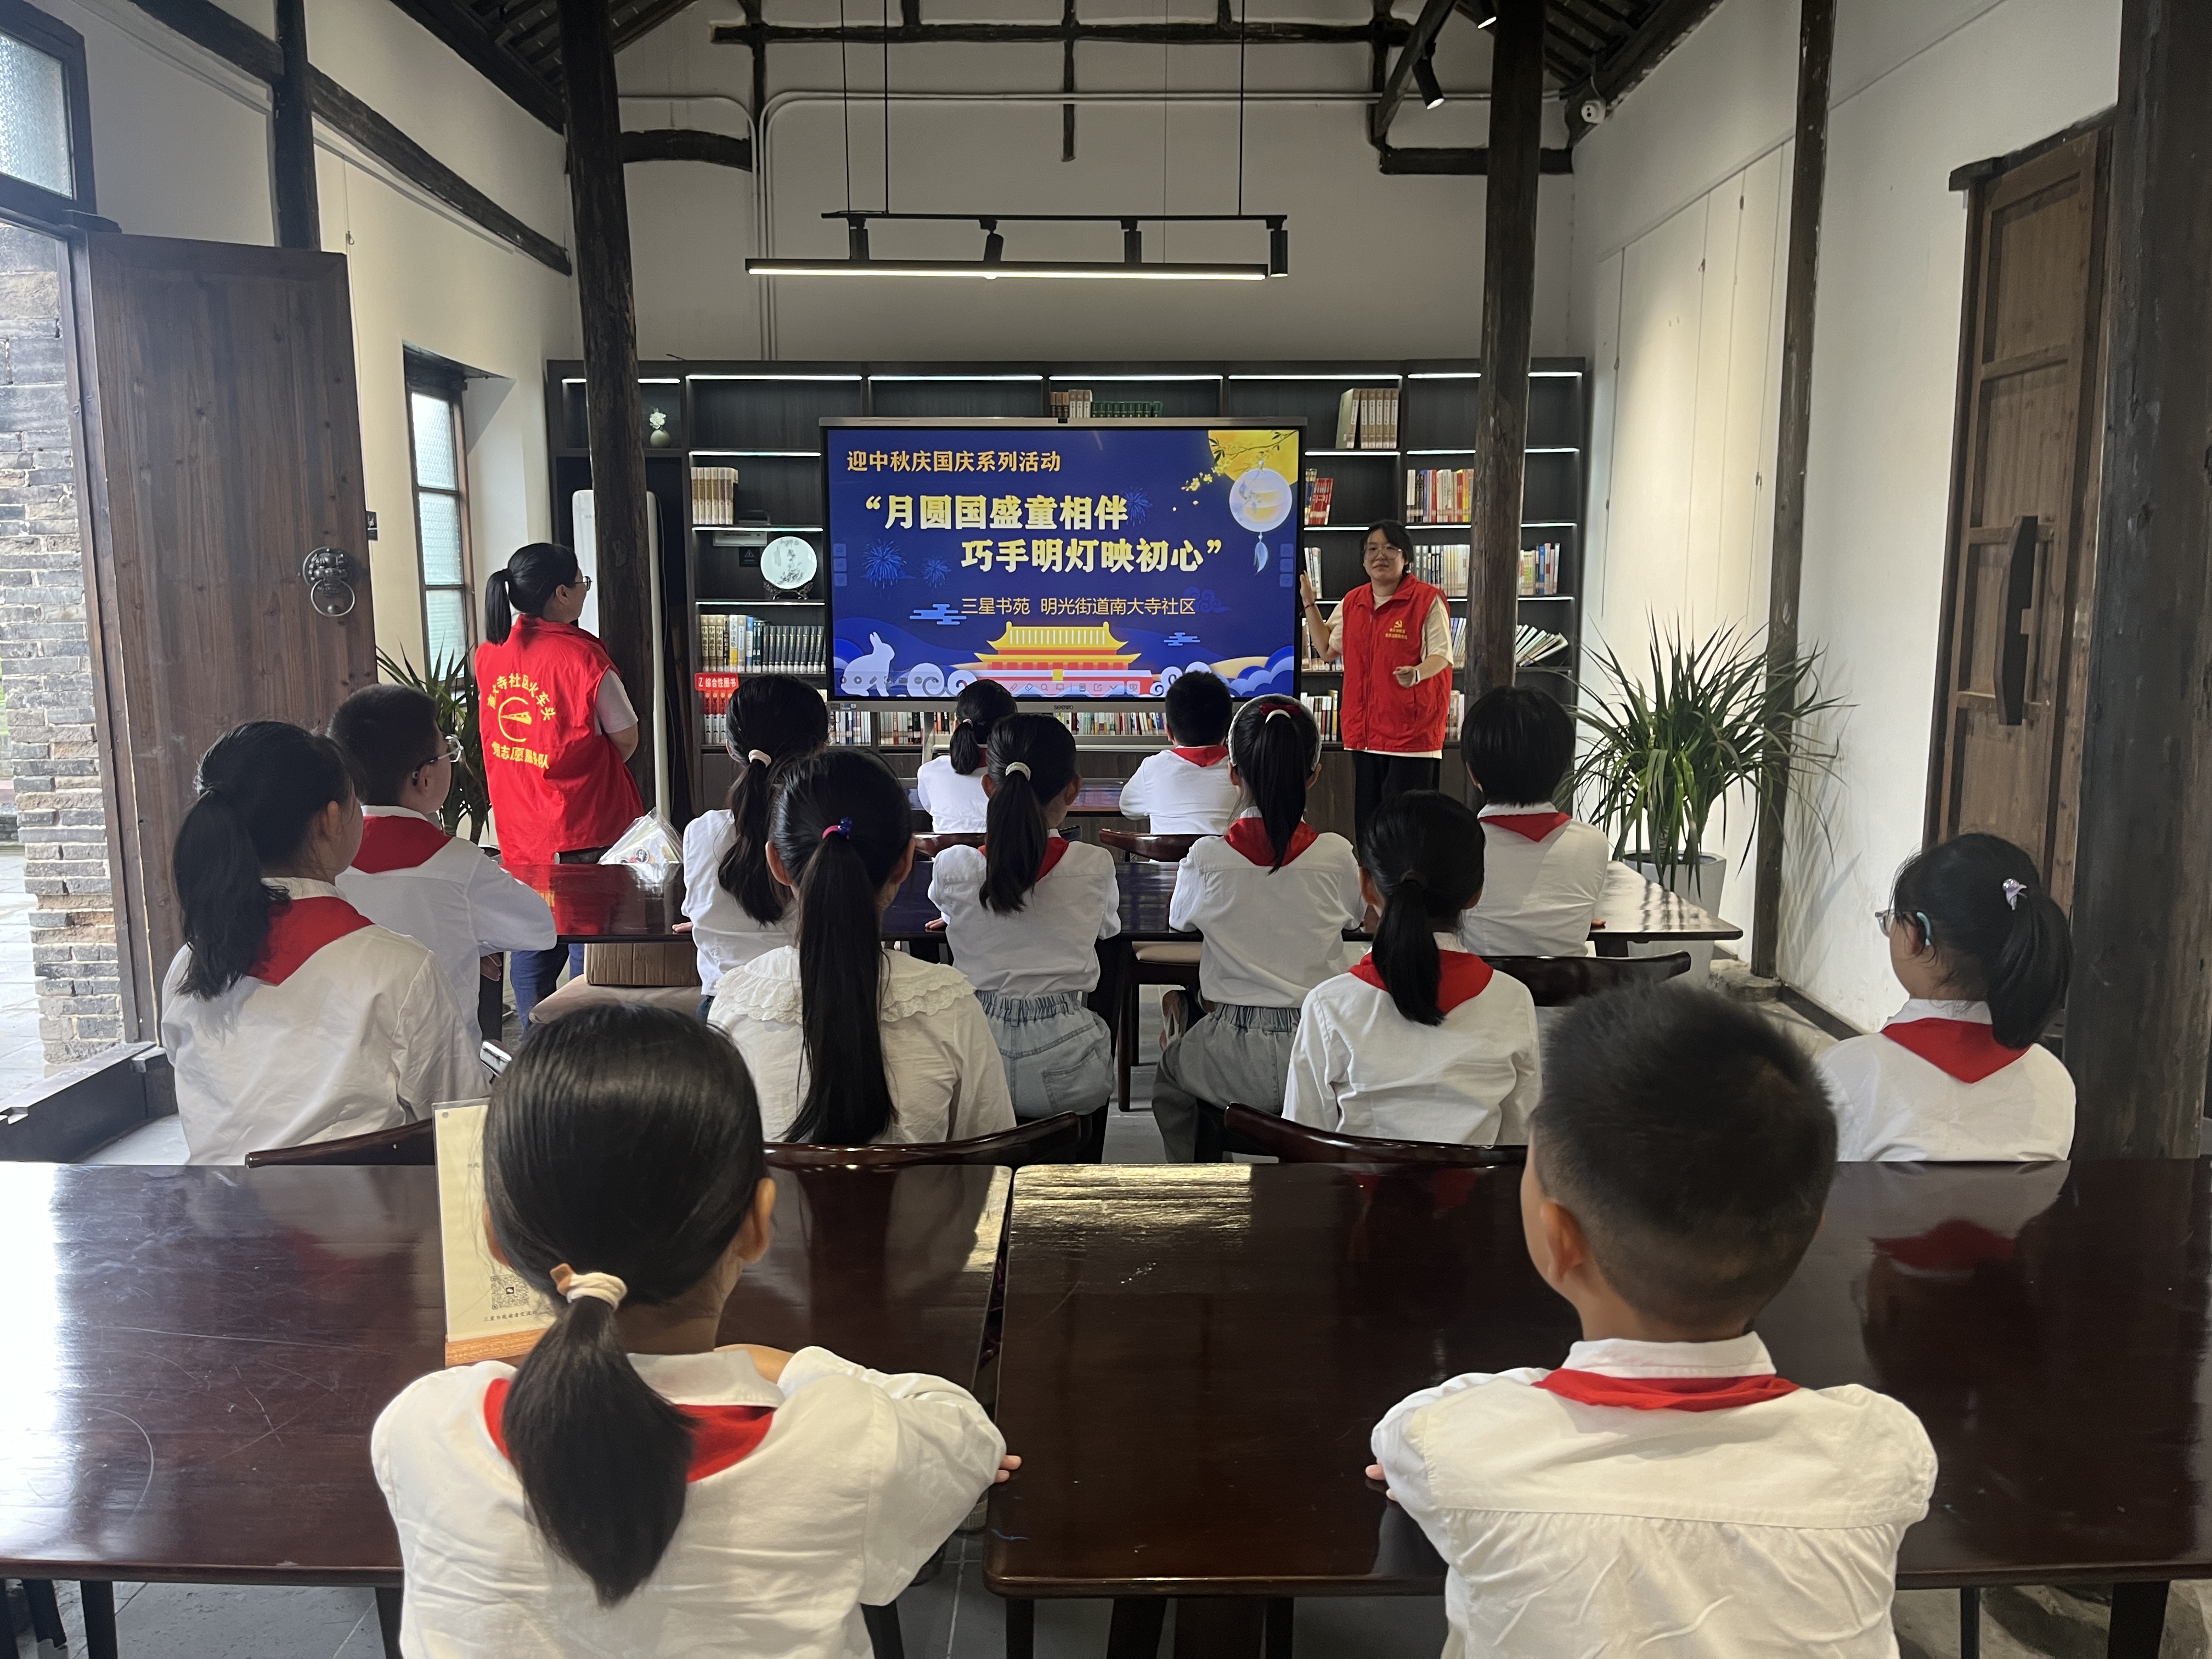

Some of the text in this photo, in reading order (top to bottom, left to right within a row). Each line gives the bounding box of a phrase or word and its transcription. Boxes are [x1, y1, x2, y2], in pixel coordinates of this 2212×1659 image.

[847, 450, 1061, 472] 迎中秋庆国庆系列活动
[866, 494, 1128, 530] “月圆国盛童相伴
[961, 538, 1222, 573] 巧手明灯映初心”
[961, 597, 1196, 616] 三星书苑 明光街道南大寺社区
[698, 677, 736, 688] Z 综合性图书
